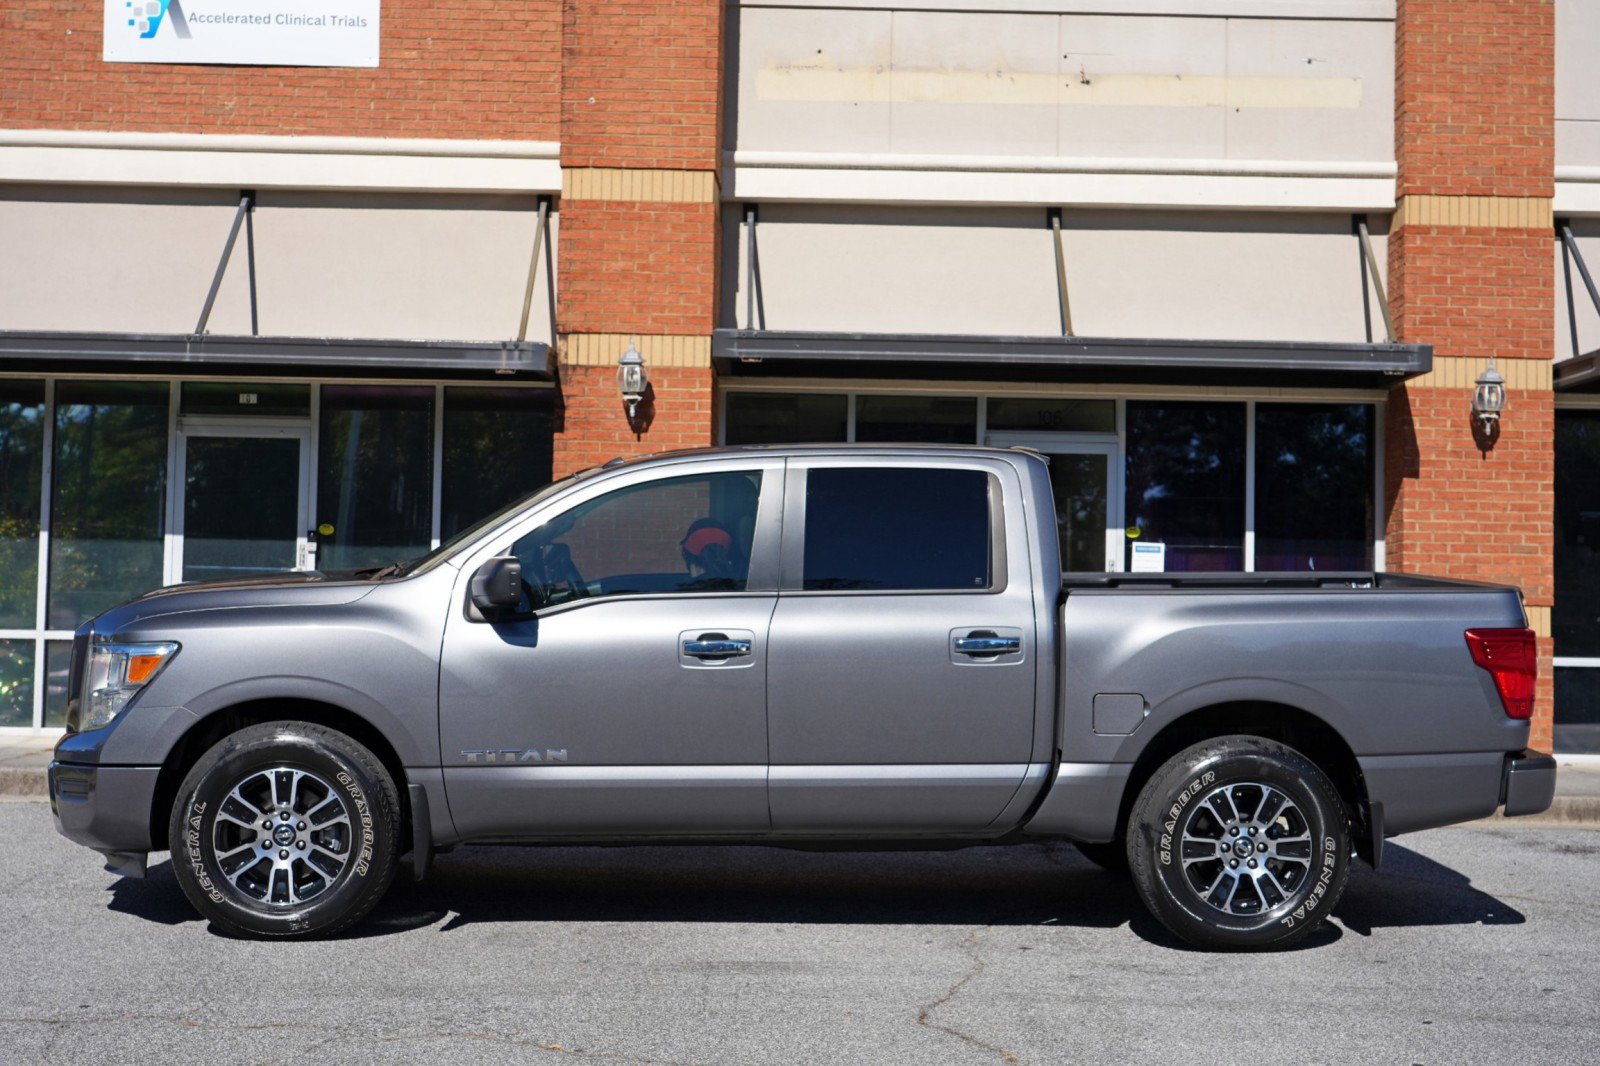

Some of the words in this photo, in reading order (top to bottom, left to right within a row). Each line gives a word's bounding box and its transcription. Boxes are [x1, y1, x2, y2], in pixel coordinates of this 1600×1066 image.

[189, 12, 271, 25] Accelerated
[275, 14, 326, 26] Clinical
[331, 15, 367, 27] Trials
[1038, 410, 1062, 425] 106
[460, 749, 568, 762] TITAN
[188, 801, 225, 904] GENERAL
[336, 771, 374, 877] GRABBER
[1160, 770, 1216, 866] GRABBER
[1281, 836, 1336, 928] GENERAL
